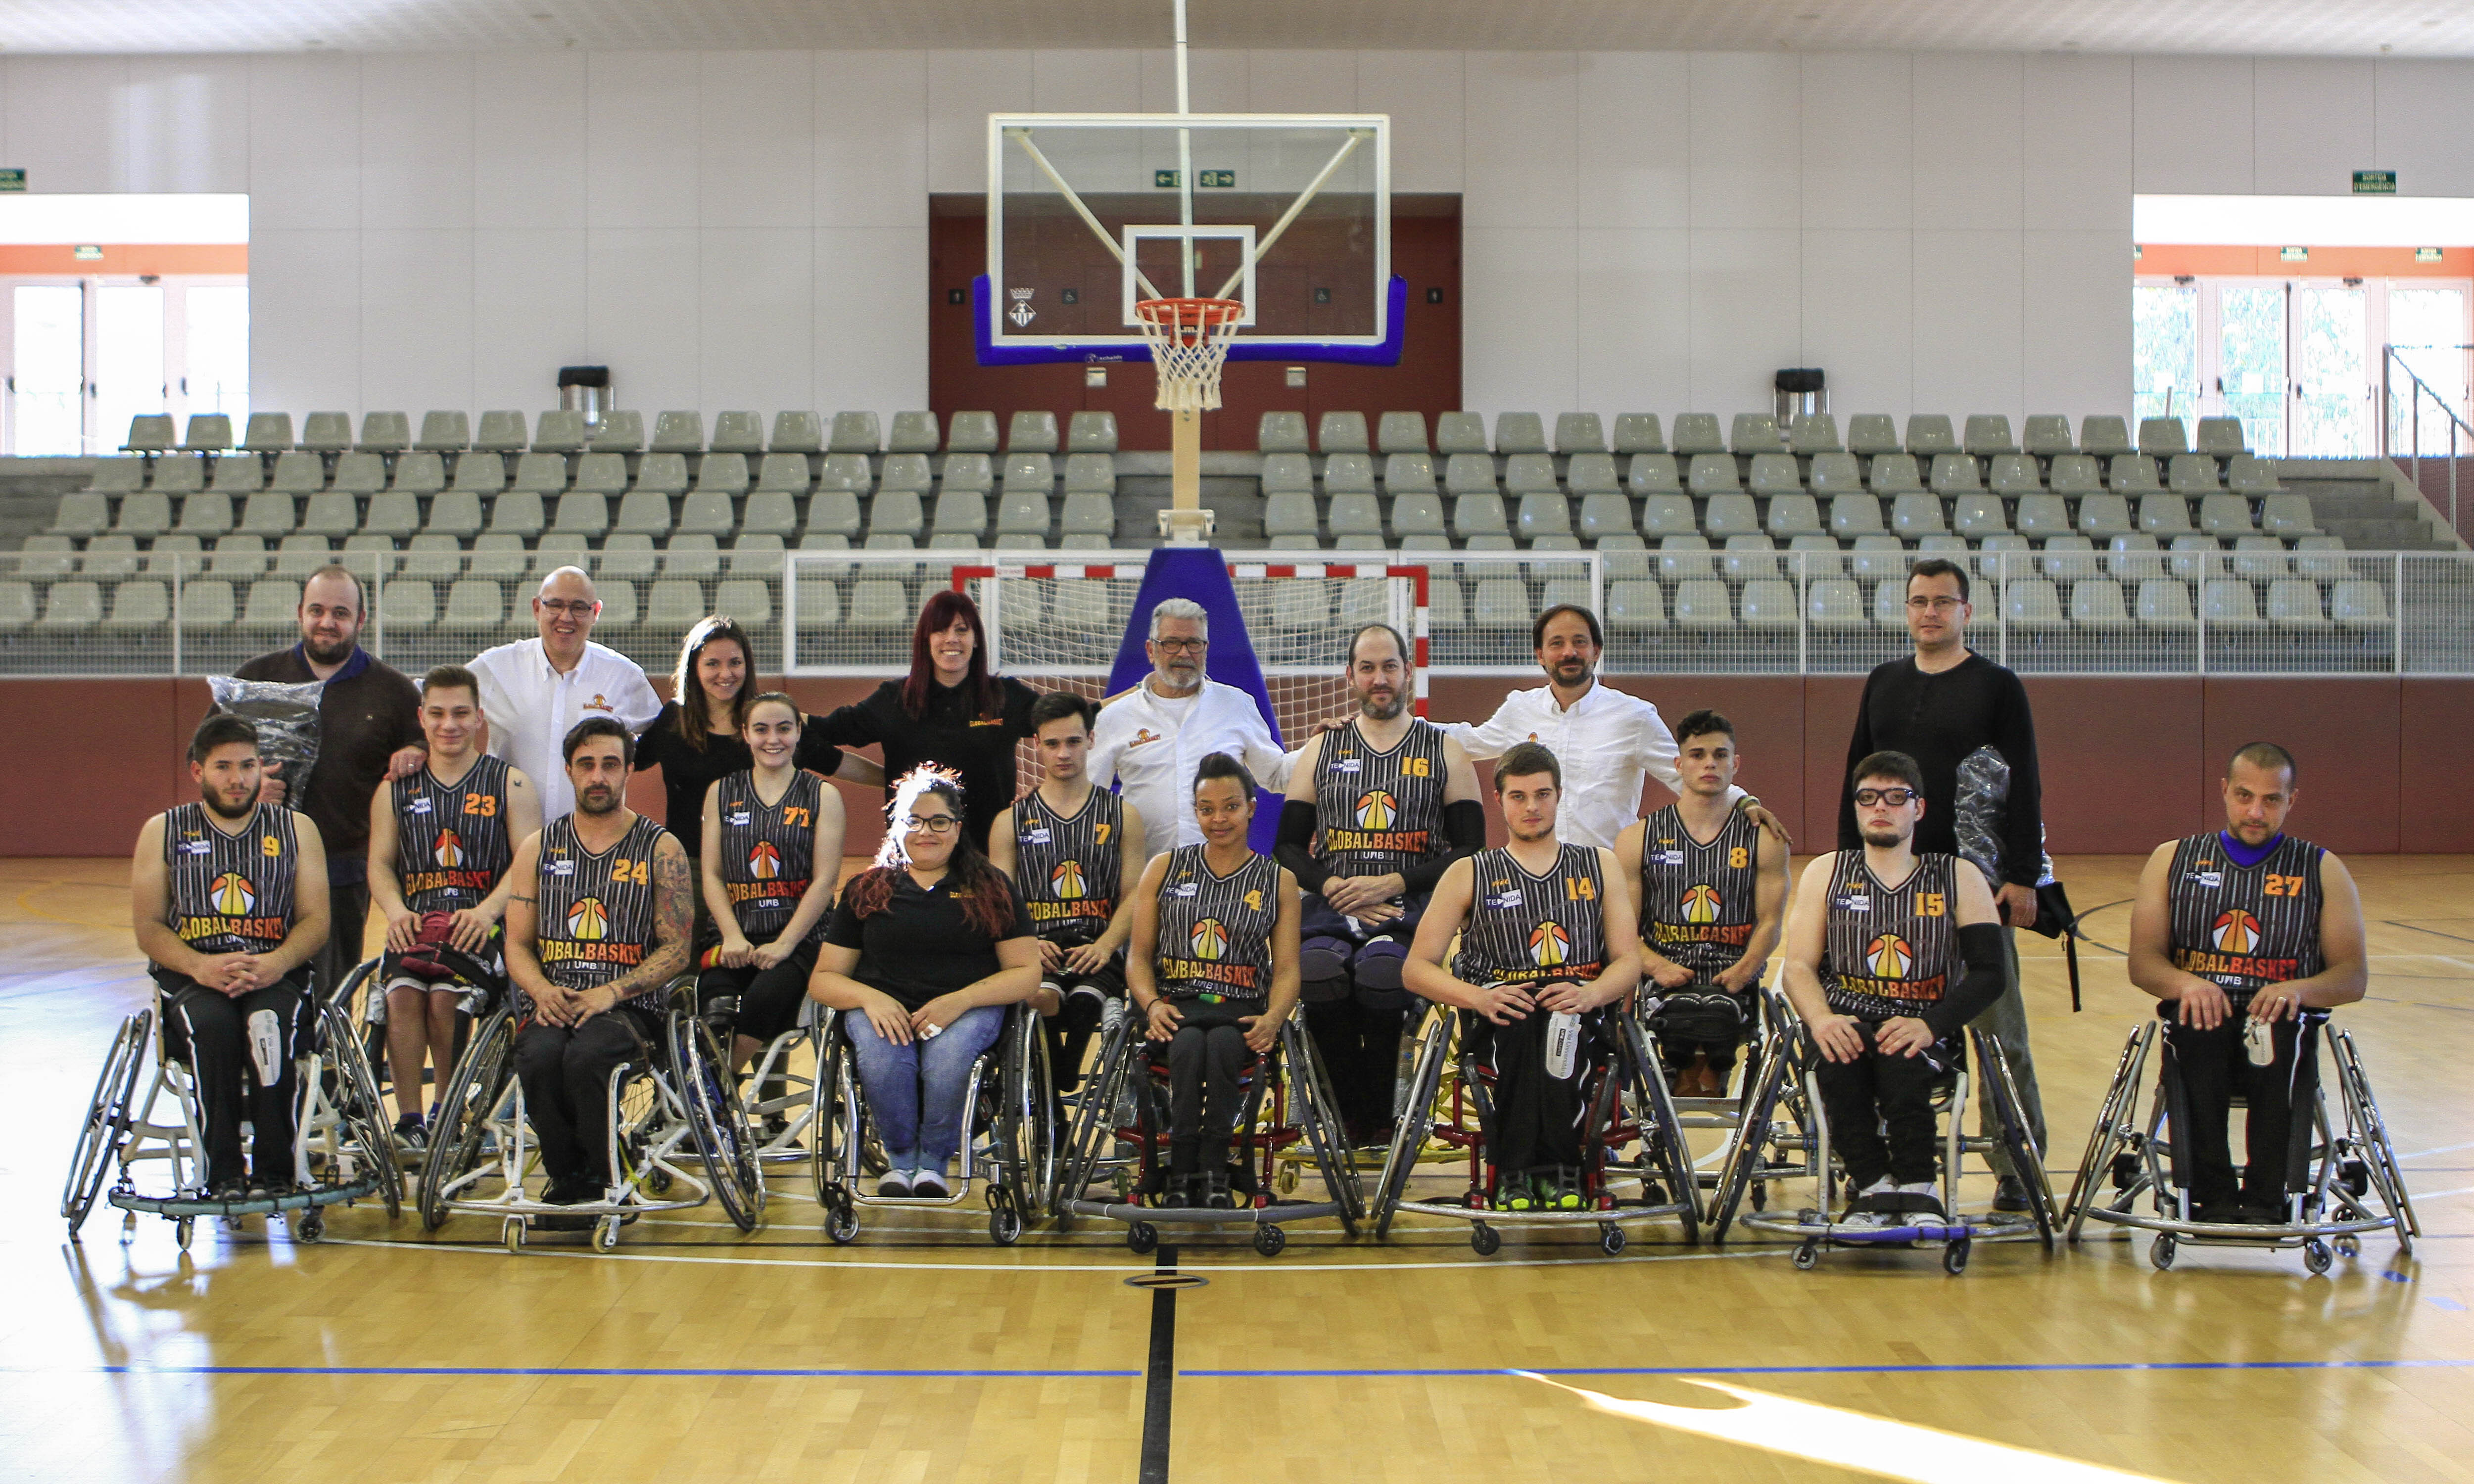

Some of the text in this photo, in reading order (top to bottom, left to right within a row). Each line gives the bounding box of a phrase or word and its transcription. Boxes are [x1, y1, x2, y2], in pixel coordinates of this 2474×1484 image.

[1401, 756, 1429, 777] 16
[464, 793, 495, 816] 23
[783, 806, 810, 827] 77
[1095, 823, 1111, 845] 7
[1327, 828, 1428, 853] GLOBALBASKET
[262, 835, 280, 857] 9
[1730, 847, 1748, 869] 8
[406, 870, 491, 896] GLOBALBASKT
[612, 858, 648, 885] 24
[1566, 877, 1595, 901] 14
[2264, 874, 2304, 897] 27
[1243, 889, 1262, 911] 4
[1915, 892, 1945, 917] 15
